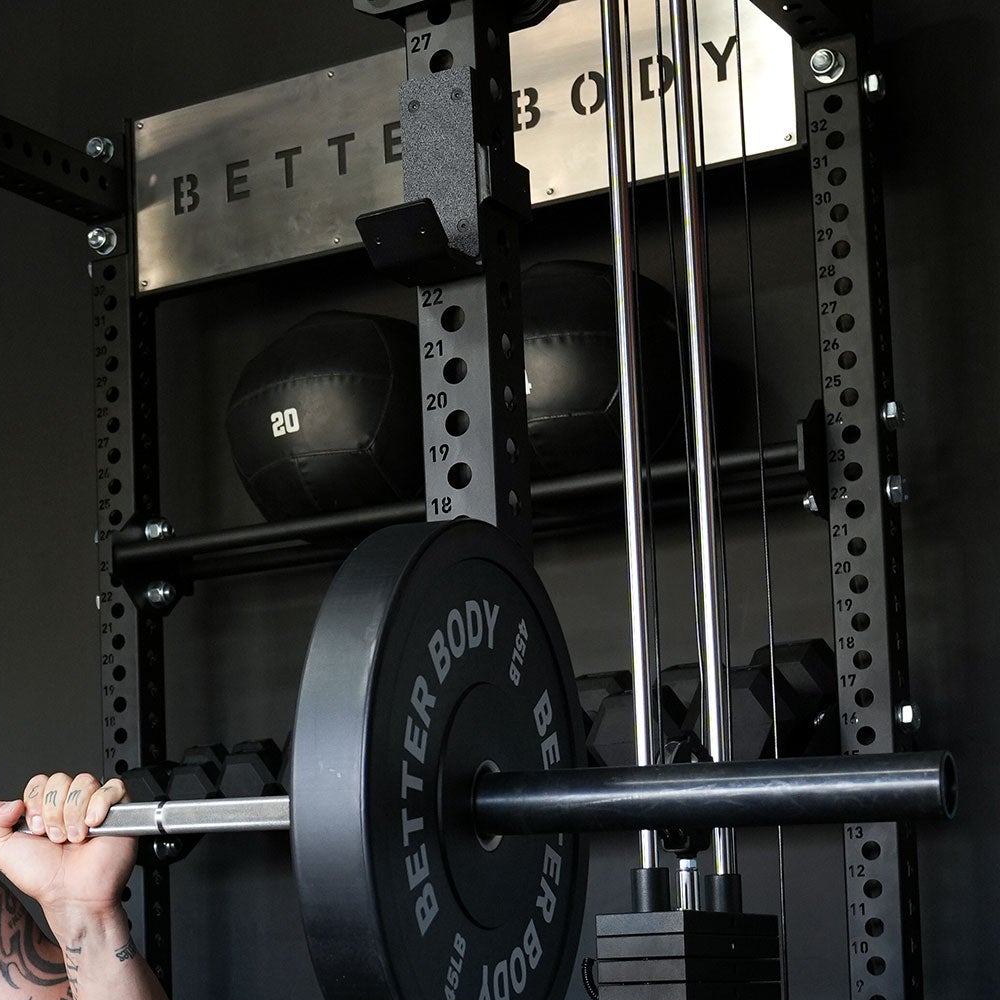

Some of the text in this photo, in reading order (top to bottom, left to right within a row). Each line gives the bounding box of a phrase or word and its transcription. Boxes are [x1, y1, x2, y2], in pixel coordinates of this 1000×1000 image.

[410, 32, 431, 53] 27
[173, 35, 737, 216] BETTE BODY
[811, 120, 828, 134] 32
[812, 156, 829, 169] 31
[815, 192, 832, 205] 30
[817, 228, 834, 242] 29
[819, 265, 836, 278] 28
[421, 288, 443, 308] 22
[821, 302, 838, 315] 27
[424, 339, 444, 359] 21
[823, 338, 840, 352] 26
[825, 375, 842, 389] 25
[426, 391, 447, 411] 20
[270, 407, 300, 438] 20
[827, 412, 844, 426] 24
[429, 443, 450, 463] 19
[829, 449, 846, 463] 23
[830, 486, 848, 500] 22
[431, 496, 452, 515] 18
[832, 524, 849, 537] 21
[834, 561, 852, 575] 20
[102, 592, 112, 602] 22
[836, 598, 853, 612] 19
[102, 622, 113, 634] 21
[838, 636, 855, 650] 18
[508, 617, 529, 687] 45LB
[103, 654, 114, 665] 20
[840, 674, 857, 687] 17
[104, 685, 114, 696] 19
[401, 598, 500, 937] BETTER BODY
[532, 688, 562, 924] BEER
[846, 826, 864, 840] 13
[848, 864, 866, 878] 12
[850, 902, 866, 916] 11
[852, 941, 869, 955] 10
